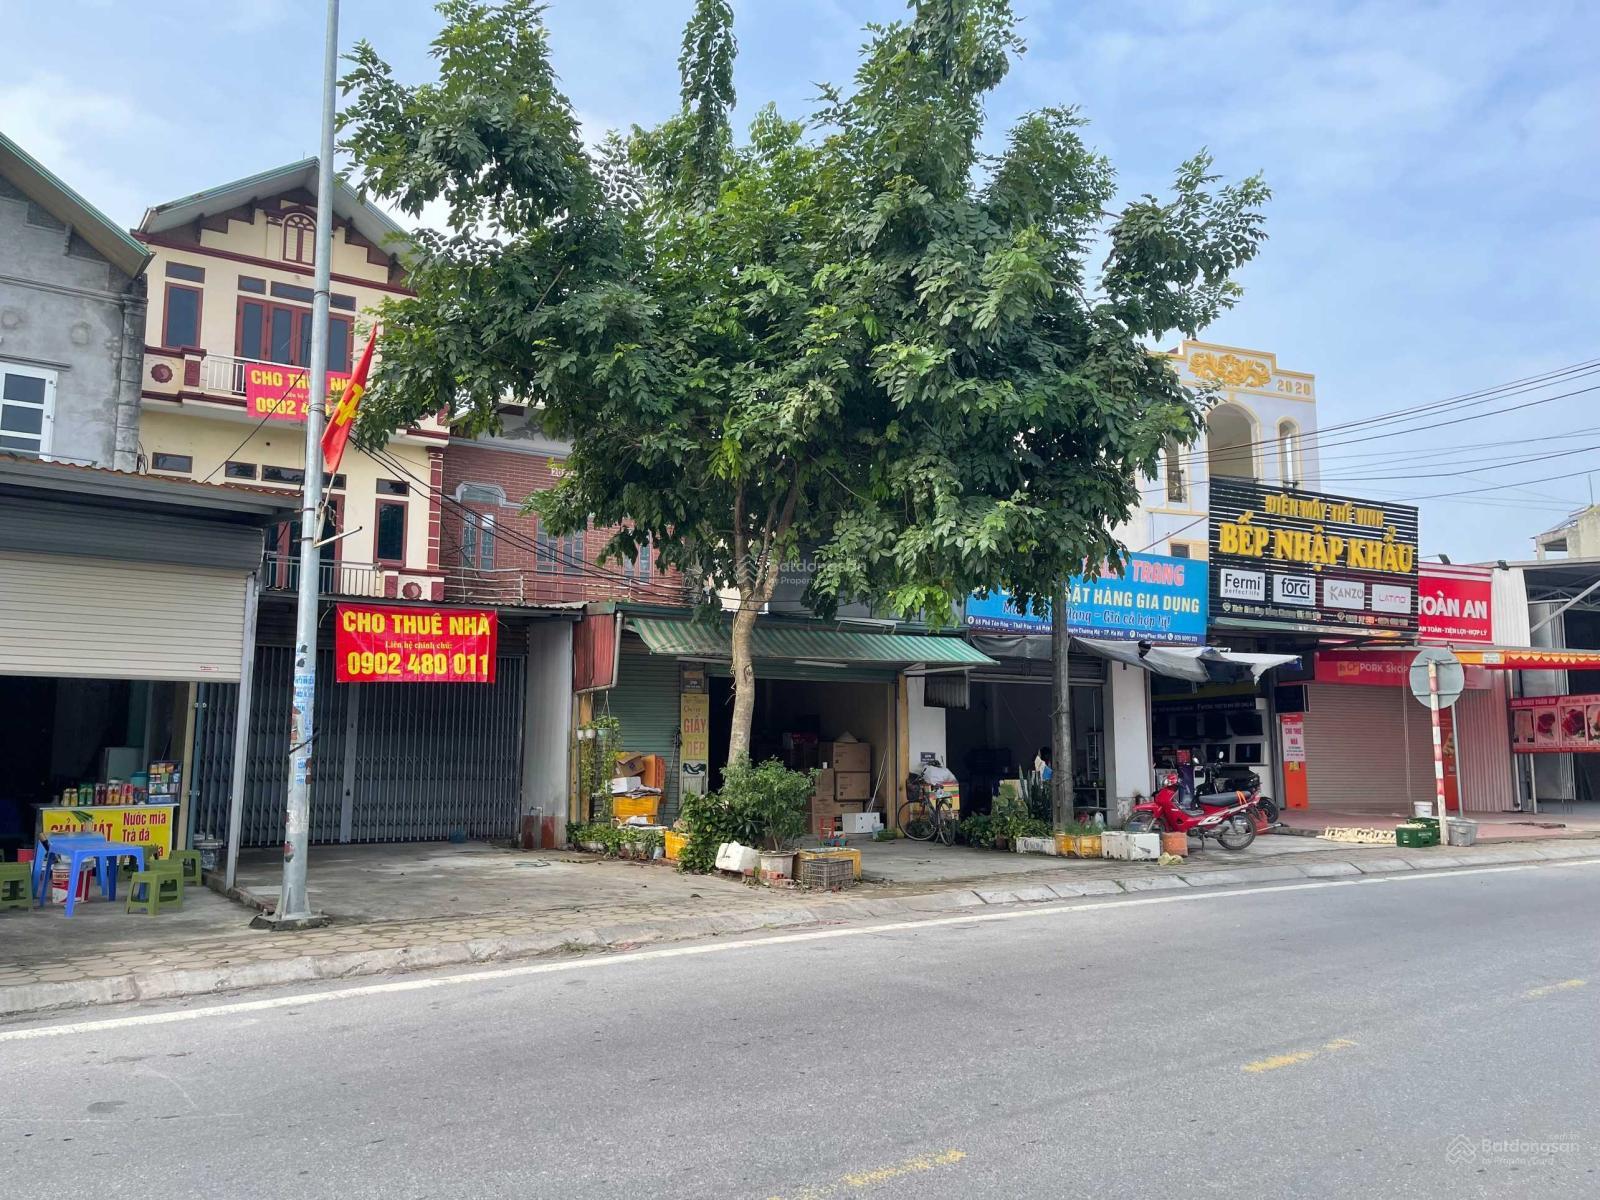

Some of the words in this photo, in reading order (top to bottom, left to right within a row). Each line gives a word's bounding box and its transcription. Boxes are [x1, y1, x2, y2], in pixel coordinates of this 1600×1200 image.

[250, 369, 283, 387] CHO
[255, 396, 297, 415] 0902
[1299, 497, 1328, 520] MÁY
[1355, 507, 1384, 528] VINH
[1218, 510, 1270, 558] BẾP
[1273, 524, 1344, 572] NHẬP
[1346, 525, 1415, 573] KHẨU
[1132, 558, 1186, 587] TRANG
[1225, 573, 1261, 591] Fermi
[1281, 577, 1310, 597] forci
[1136, 592, 1160, 611] GIA
[1163, 595, 1200, 615] DỤNG
[1462, 599, 1488, 620] AN
[343, 611, 386, 634] CHO
[392, 613, 443, 636] THUÊ
[449, 613, 491, 636] NHÀ
[347, 651, 401, 676] 0902
[407, 653, 448, 675] 480
[453, 653, 489, 676] 011
[1359, 662, 1383, 673] PORK
[1386, 664, 1409, 674] SHOP
